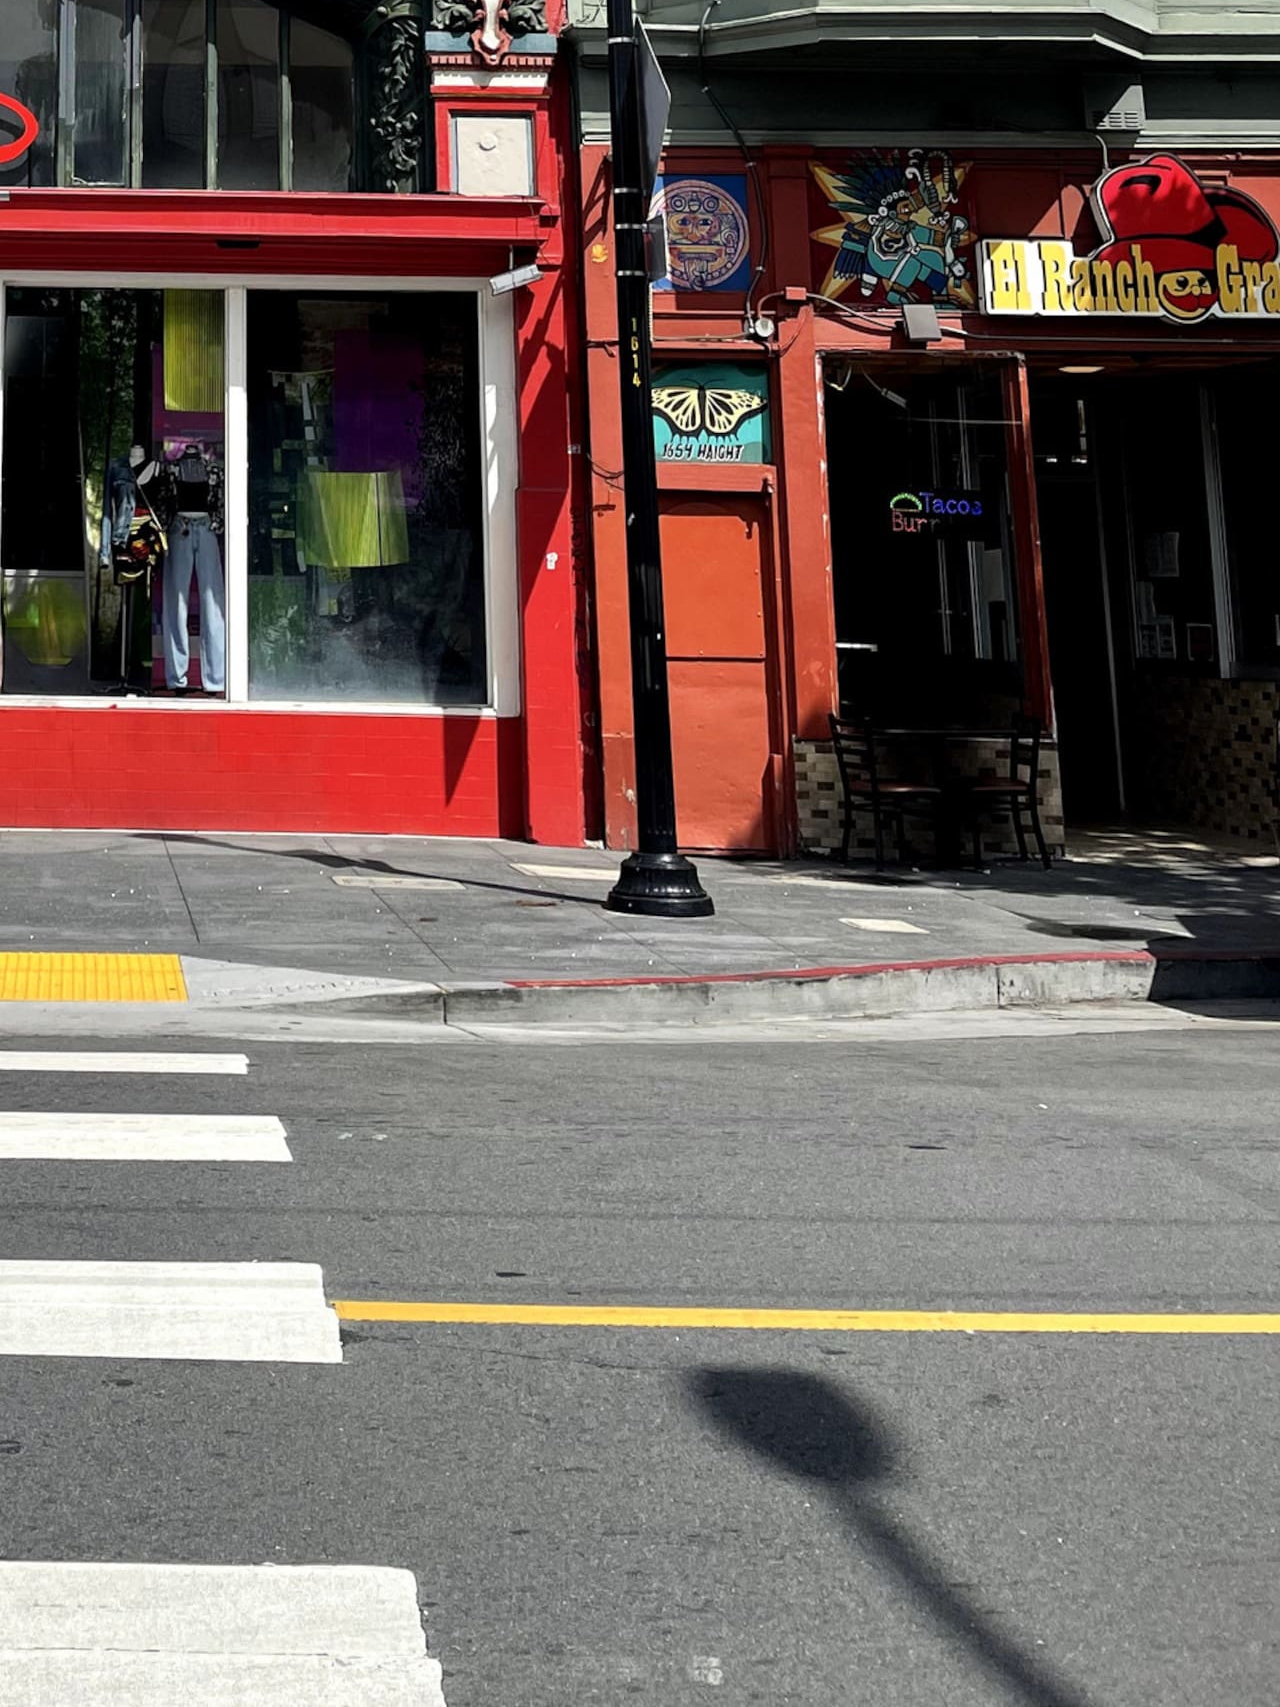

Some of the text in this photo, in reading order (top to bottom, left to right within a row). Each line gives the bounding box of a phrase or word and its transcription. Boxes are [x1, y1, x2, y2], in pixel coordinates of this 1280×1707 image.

[990, 240, 1031, 311] El
[630, 317, 642, 387] 1614
[663, 443, 745, 462] 1654 HAIGHT
[919, 492, 982, 515] Tacos
